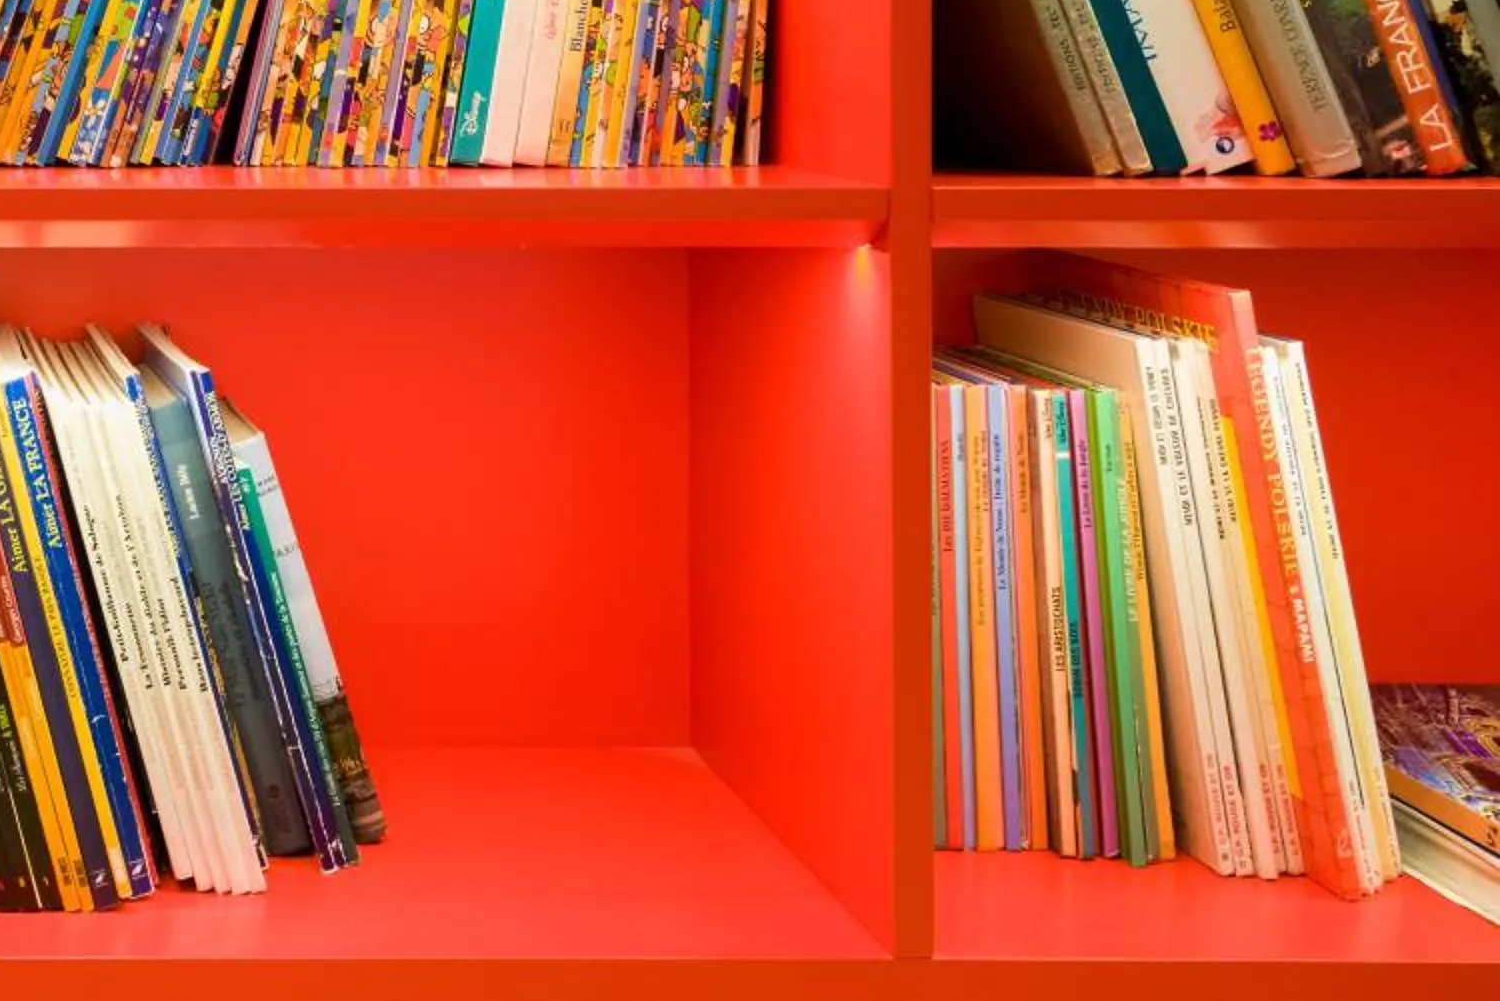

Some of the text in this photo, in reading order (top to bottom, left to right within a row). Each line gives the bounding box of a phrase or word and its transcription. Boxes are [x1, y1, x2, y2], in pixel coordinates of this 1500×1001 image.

[1417, 104, 1455, 153] LA
[10, 397, 63, 550] Aimer LA FRANCE
[1244, 345, 1279, 462] LEGENDY
[1267, 471, 1300, 577] POLSKIE
[1290, 596, 1316, 664] MAPAMI
[2, 526, 28, 574] Aimer
